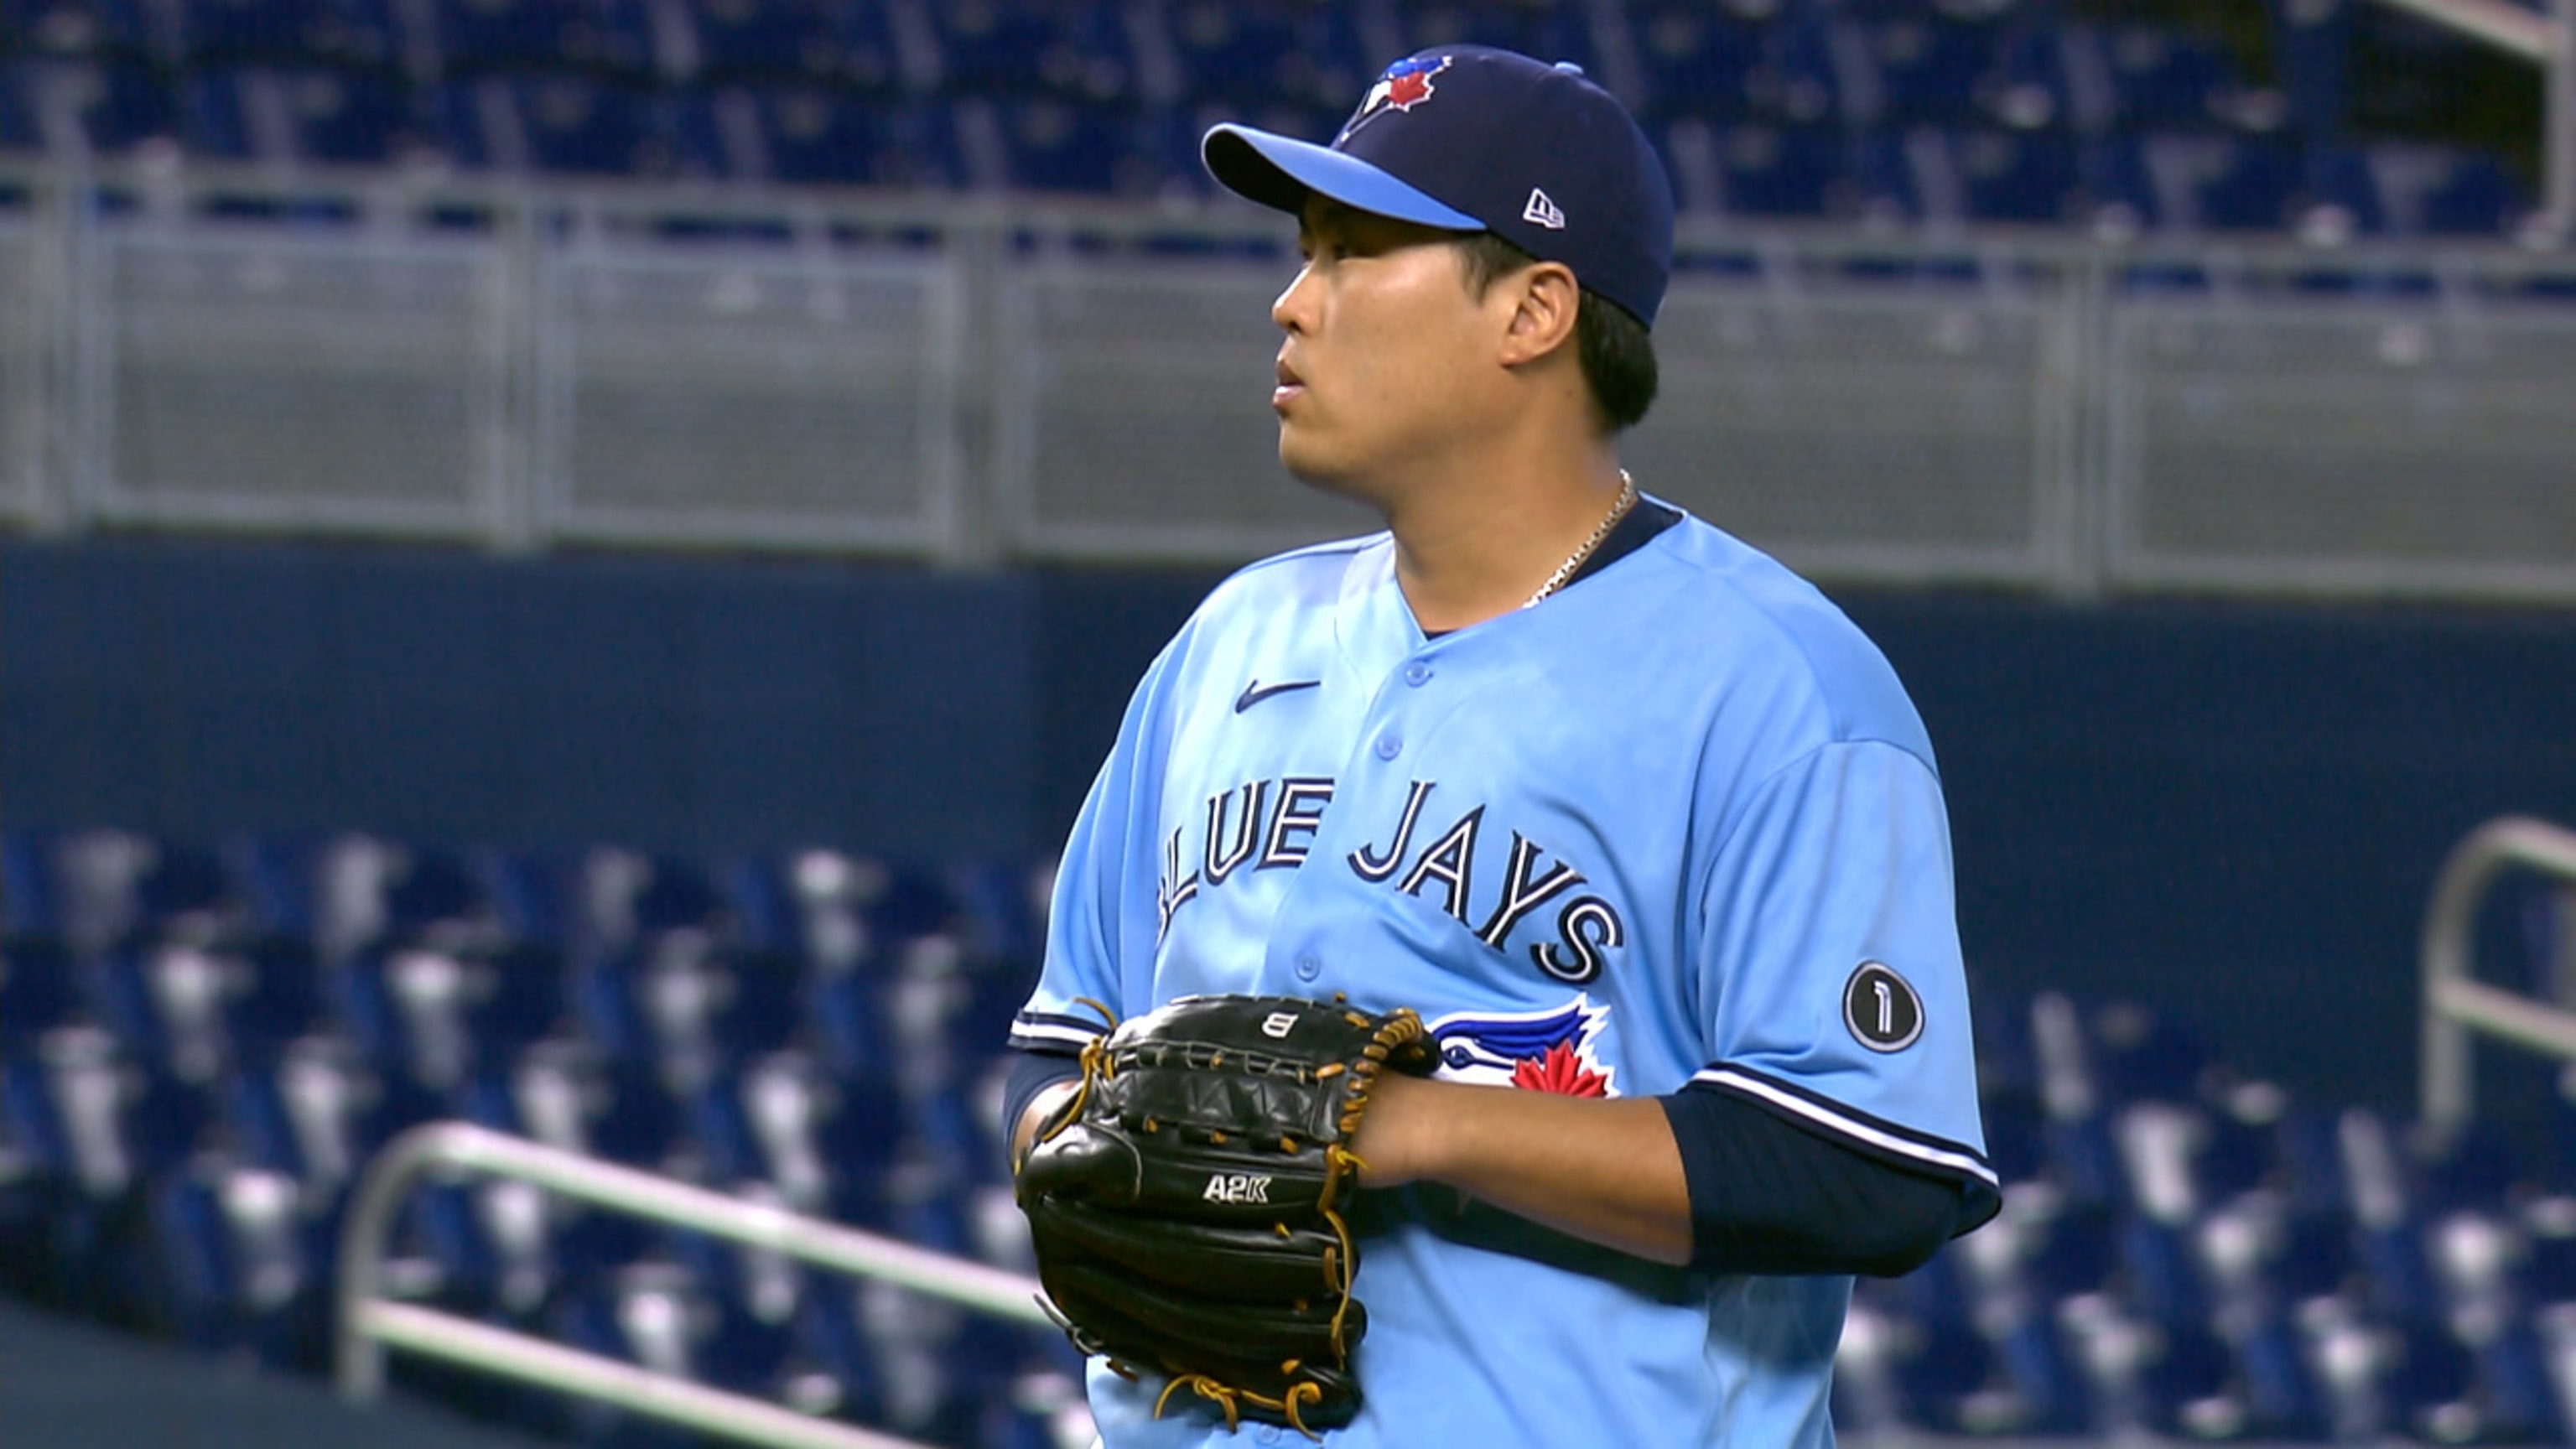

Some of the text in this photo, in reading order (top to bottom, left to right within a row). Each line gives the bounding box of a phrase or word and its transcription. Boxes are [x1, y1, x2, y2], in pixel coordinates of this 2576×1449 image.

[1348, 780, 1624, 984] JAYS
[1872, 980, 1893, 1034] 1
[1202, 1175, 1272, 1203] A2K
